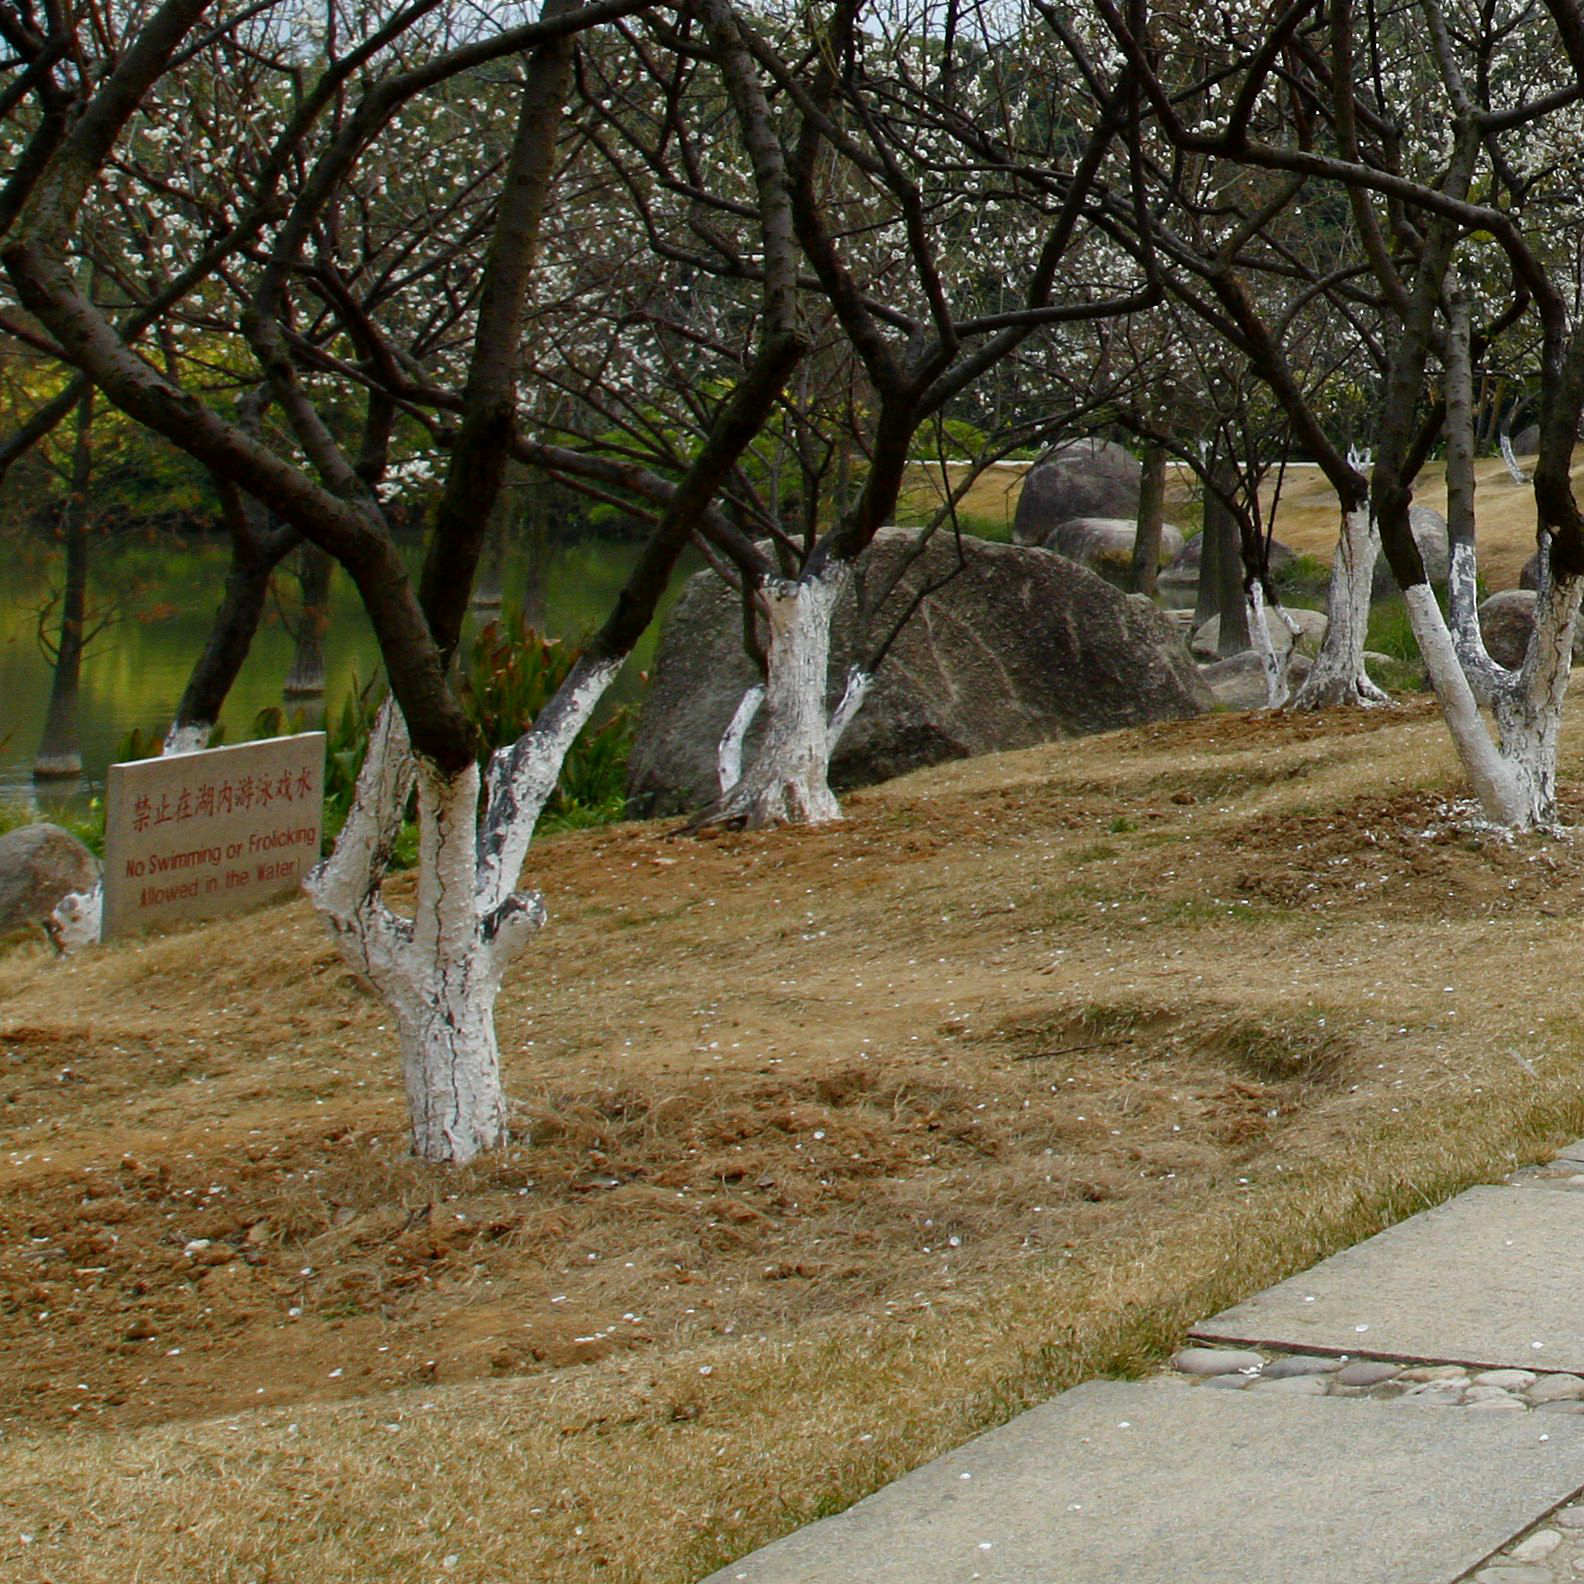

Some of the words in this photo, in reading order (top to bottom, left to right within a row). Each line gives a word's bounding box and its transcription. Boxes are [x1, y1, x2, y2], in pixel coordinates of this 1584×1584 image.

[133, 767, 313, 832] 禁止在湖内游泳戏水
[127, 858, 145, 877] No
[149, 844, 221, 874] Swimming
[226, 844, 243, 859] or
[249, 827, 316, 853] Frolicking
[140, 879, 198, 908] Allowed
[206, 875, 217, 893] in
[226, 867, 249, 889] the
